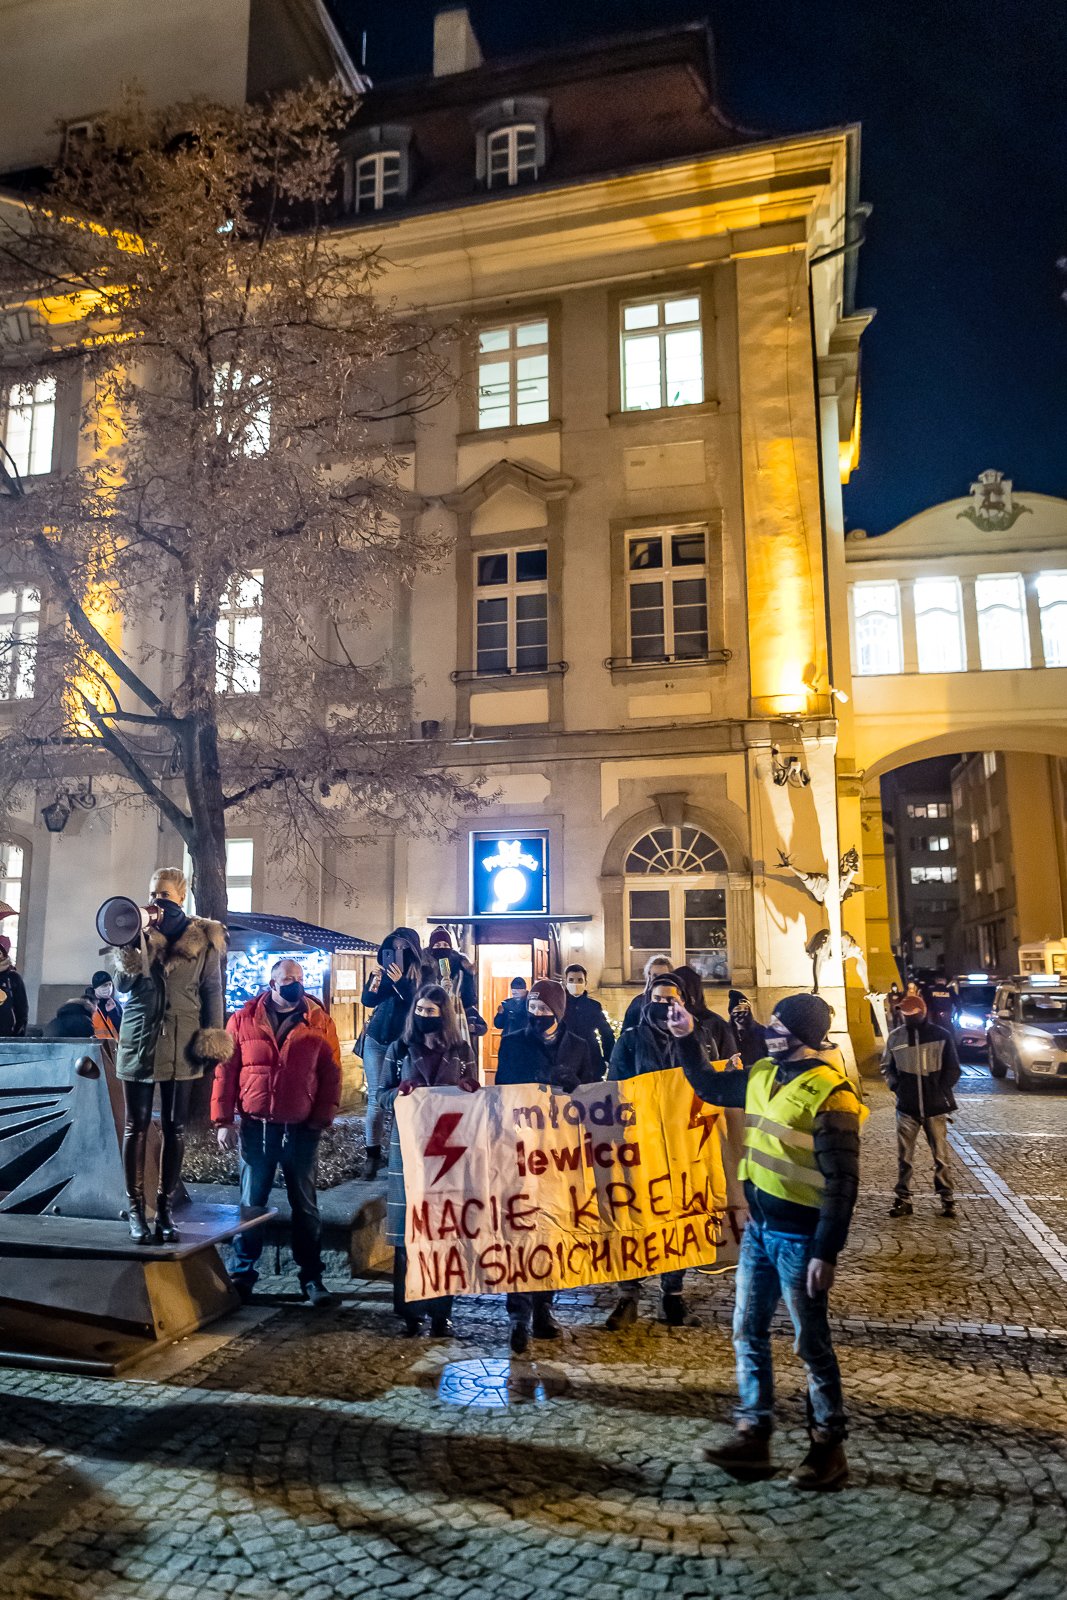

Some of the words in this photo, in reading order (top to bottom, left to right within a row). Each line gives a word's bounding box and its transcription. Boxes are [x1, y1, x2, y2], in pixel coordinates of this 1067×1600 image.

[516, 1131, 642, 1177] lewica
[410, 1193, 541, 1244] MACIE
[569, 1171, 710, 1228] KREW
[418, 1245, 467, 1298] NA
[479, 1237, 612, 1286] SWOICH
